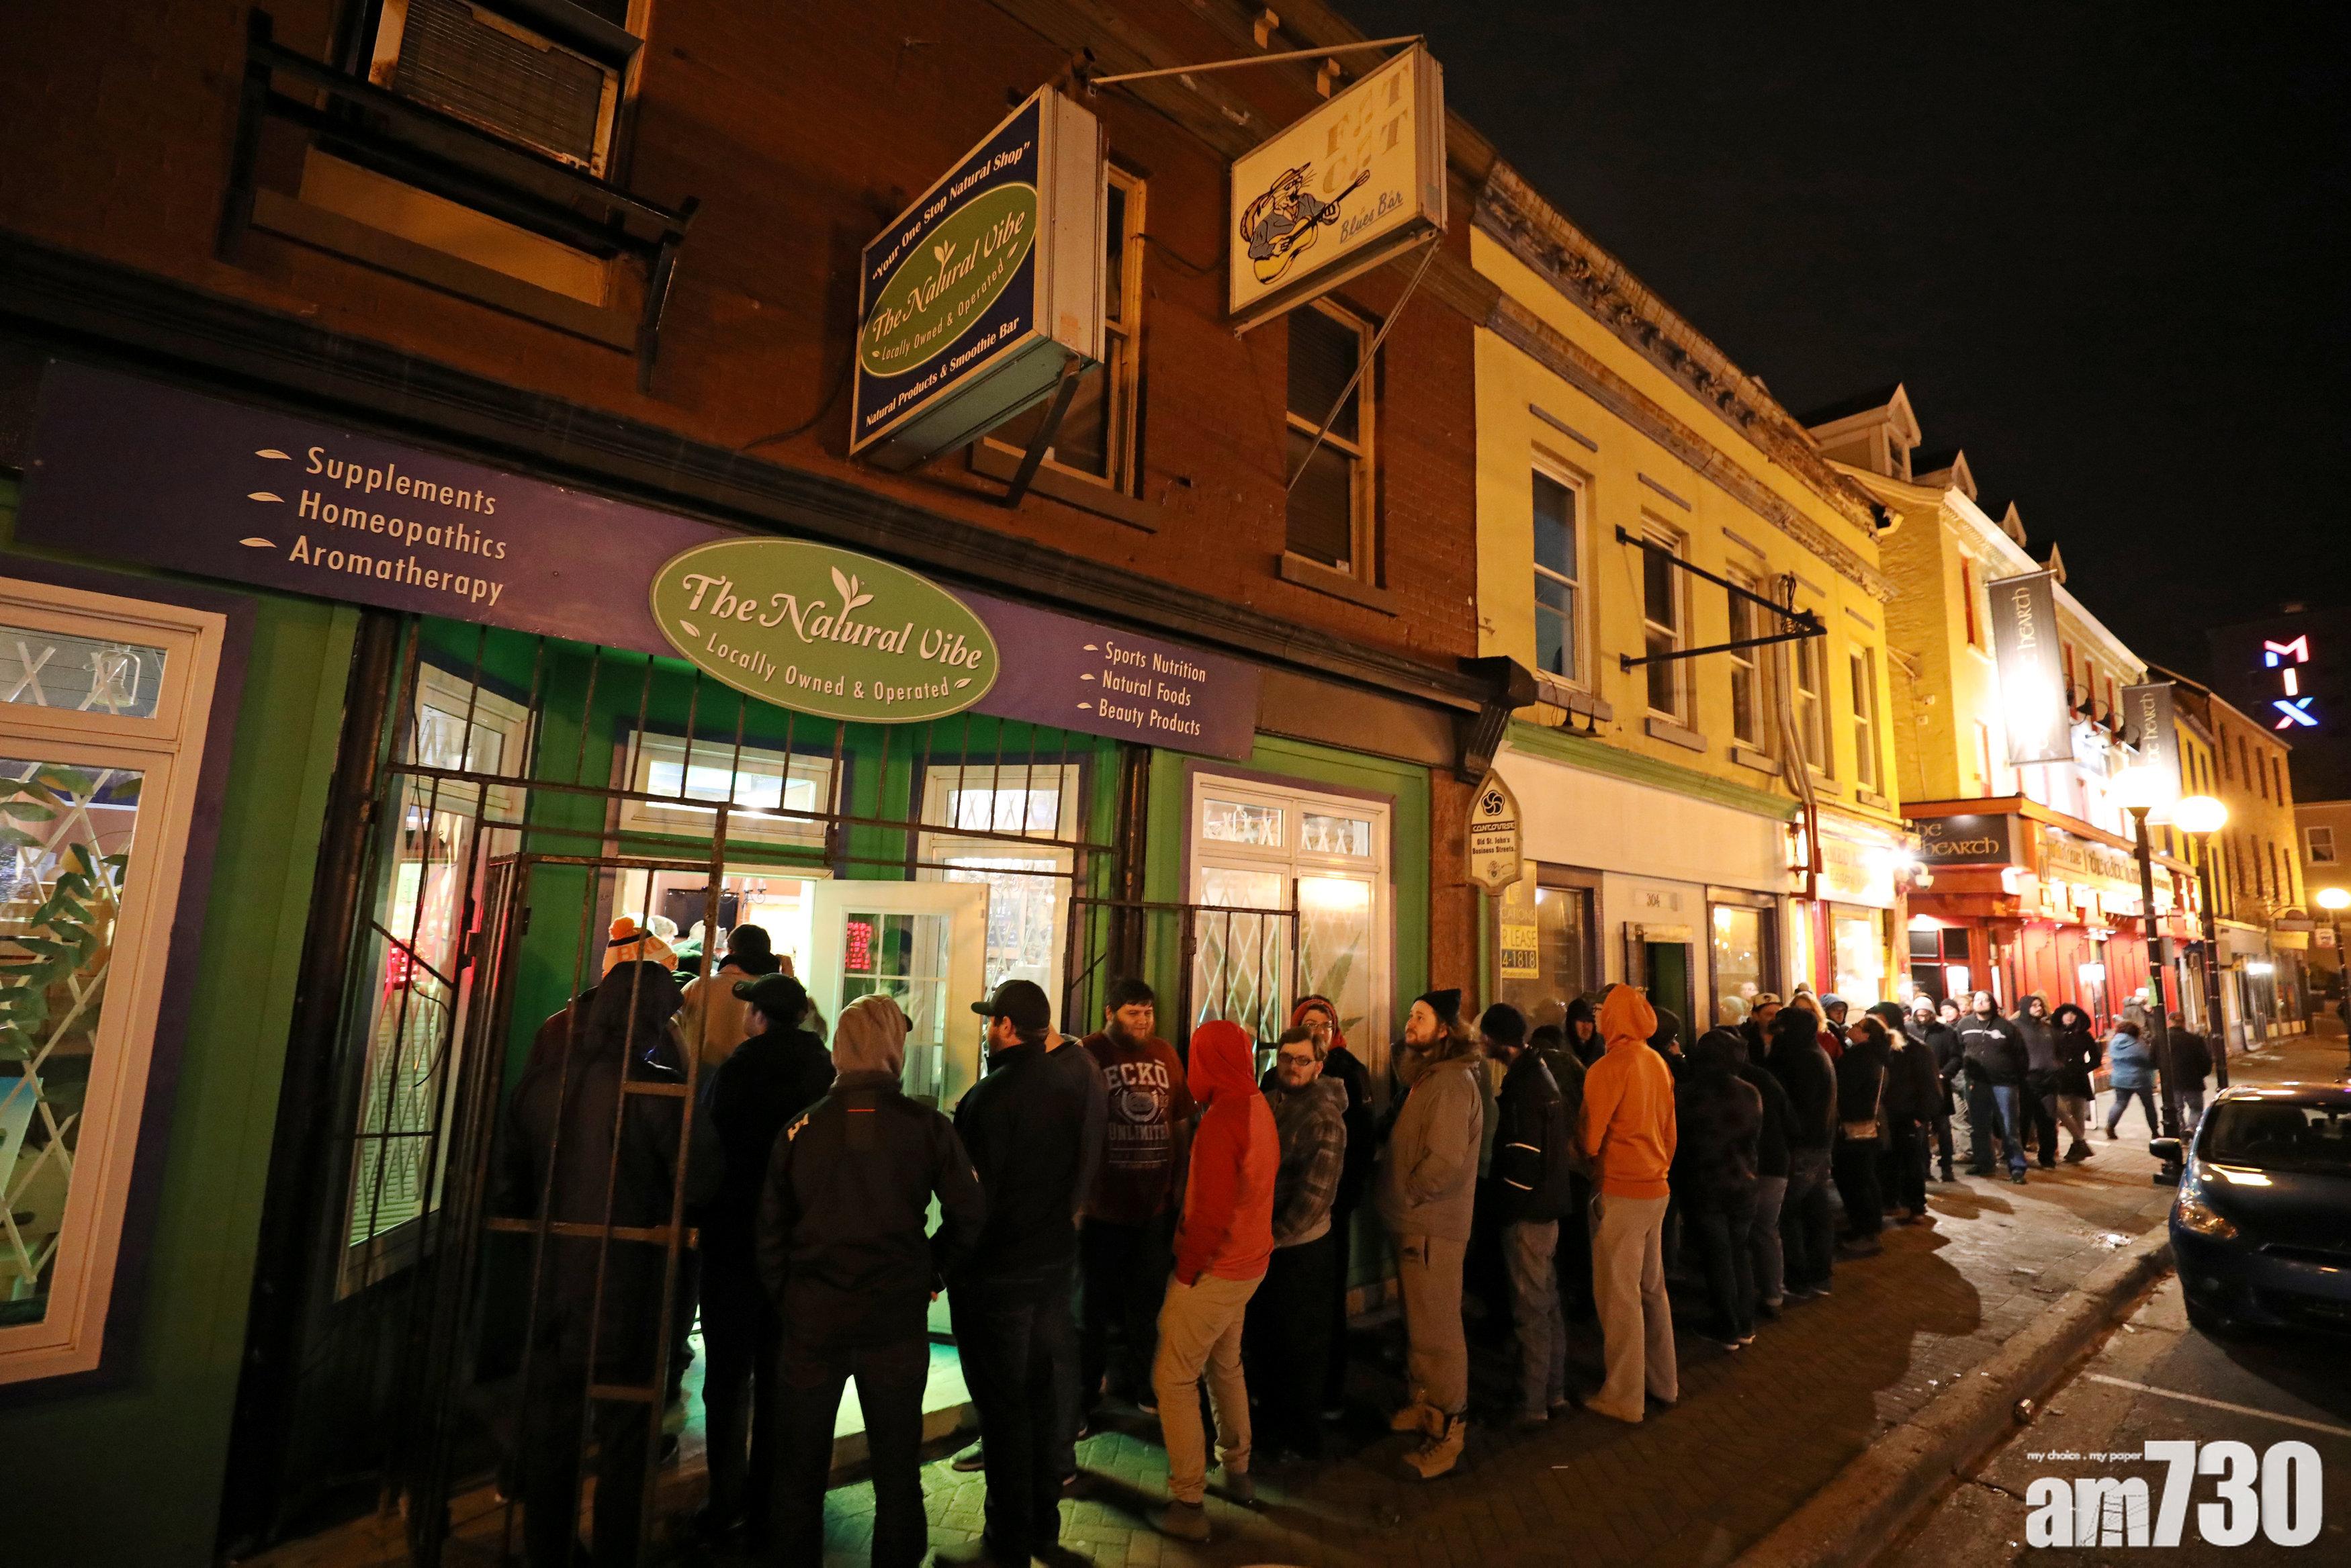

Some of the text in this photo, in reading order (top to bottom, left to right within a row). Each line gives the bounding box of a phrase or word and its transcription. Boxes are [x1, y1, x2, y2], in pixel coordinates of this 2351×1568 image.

[901, 222, 921, 247] One
[924, 198, 946, 224] Stop
[950, 163, 990, 200] Natural
[1340, 192, 1403, 243] Blues Bar
[873, 211, 1026, 343] The Natural Vibe
[881, 263, 1004, 361] Locally Owned & Operated
[866, 317, 1020, 427] Natural Products & Smoothie Bar
[306, 447, 496, 515] Supplements
[298, 490, 506, 559] Homeopathics
[289, 535, 503, 606] Aromatherapy
[682, 573, 981, 670] The Natural Vibe
[707, 633, 948, 704] Locally Owned & Operated
[1102, 670, 1191, 706] Natural Foods
[1105, 641, 1206, 682] Sports Nutrition
[1099, 698, 1200, 736] Beauty Products
[1472, 822, 1515, 831] CONCOURSE
[1511, 930, 1536, 948] LEASE
